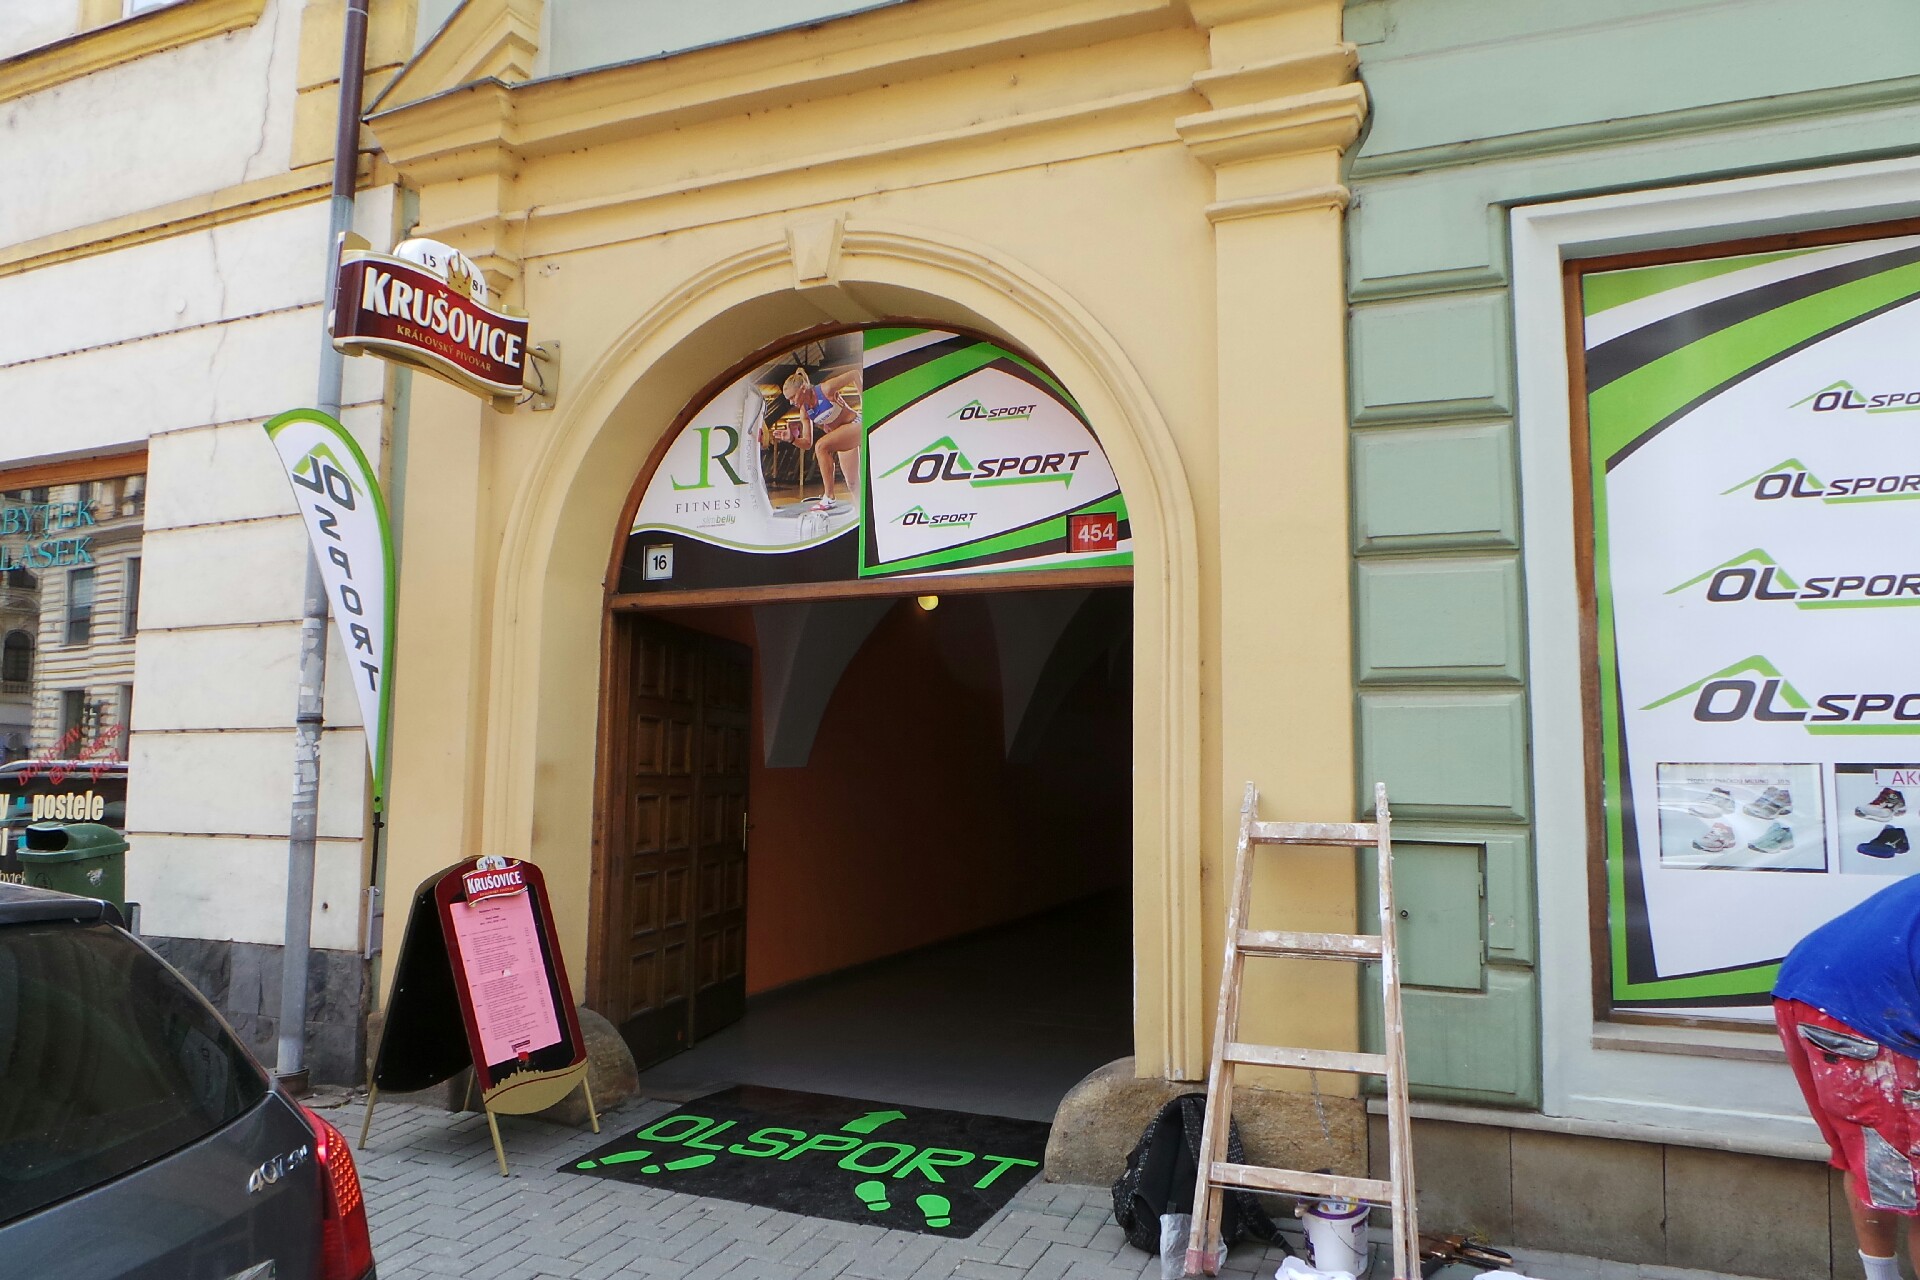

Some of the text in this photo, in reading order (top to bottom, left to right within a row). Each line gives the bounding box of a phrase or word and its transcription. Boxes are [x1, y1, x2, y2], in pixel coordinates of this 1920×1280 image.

[423, 253, 484, 295] 15 81
[362, 266, 523, 369] KRUŠOVICE
[397, 324, 492, 372] KRÁLOVSKÝ PIVOVAR
[676, 498, 741, 513] FITNESS
[1078, 523, 1114, 542] 454
[652, 555, 667, 571] 16
[1892, 771, 1920, 785] AK
[32, 790, 104, 821] postele
[467, 871, 522, 894] KRUŠOVICE
[637, 1115, 1039, 1189] OLSPORT
[247, 1153, 284, 1193] 407
